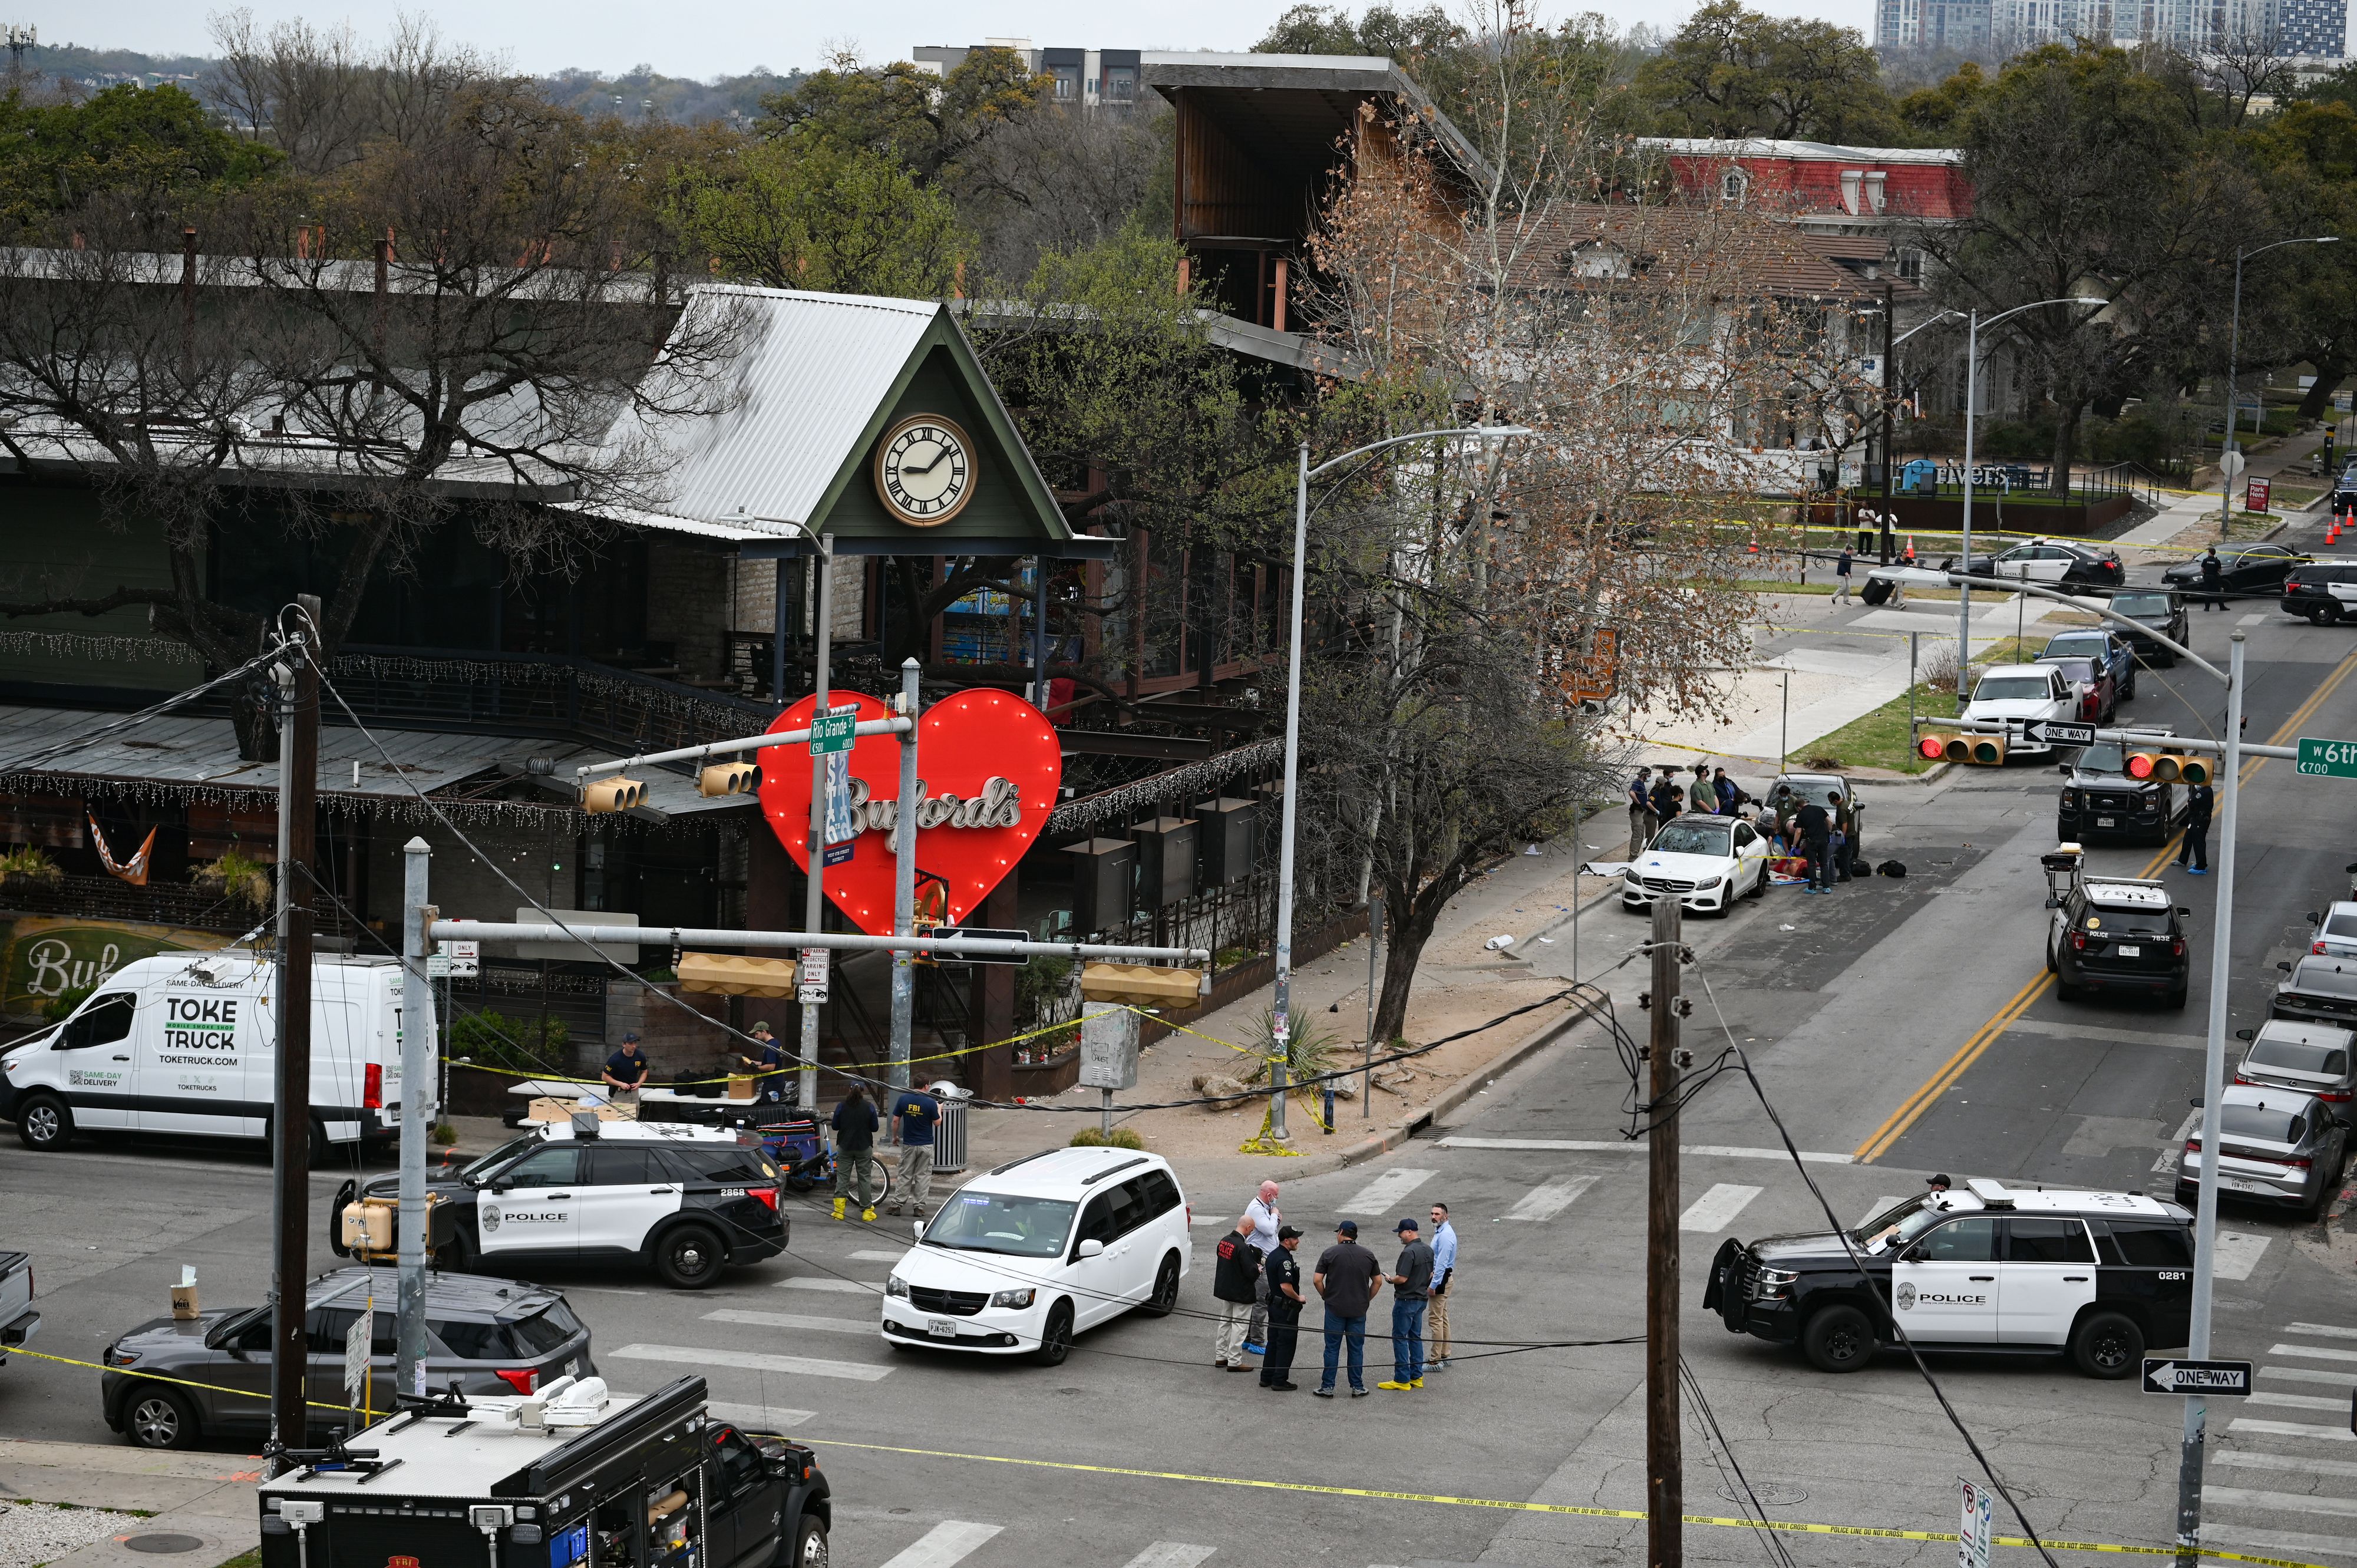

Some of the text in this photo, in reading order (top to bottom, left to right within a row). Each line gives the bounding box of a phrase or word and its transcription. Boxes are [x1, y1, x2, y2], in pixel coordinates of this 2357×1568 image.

[1935, 458, 2006, 485] rivers
[813, 717, 854, 739] Rio Grande ST
[2045, 728, 2087, 739] ONE WAY
[816, 742, 824, 752] 500
[2313, 746, 2322, 757] W
[2308, 762, 2328, 774] 700
[166, 979, 206, 988] SAME-DAY
[167, 998, 237, 1023] TOKE
[165, 1030, 235, 1050] TRUCK
[159, 1055, 237, 1066] TOKETRUCK.COM
[721, 1188, 745, 1196] 2868
[2159, 1272, 2185, 1280] 0281
[1920, 1294, 1986, 1303] POLICE
[2176, 1371, 2239, 1385] ONE WAY
[1981, 1528, 1985, 1537] TO
[395, 1559, 412, 1567] FBI
